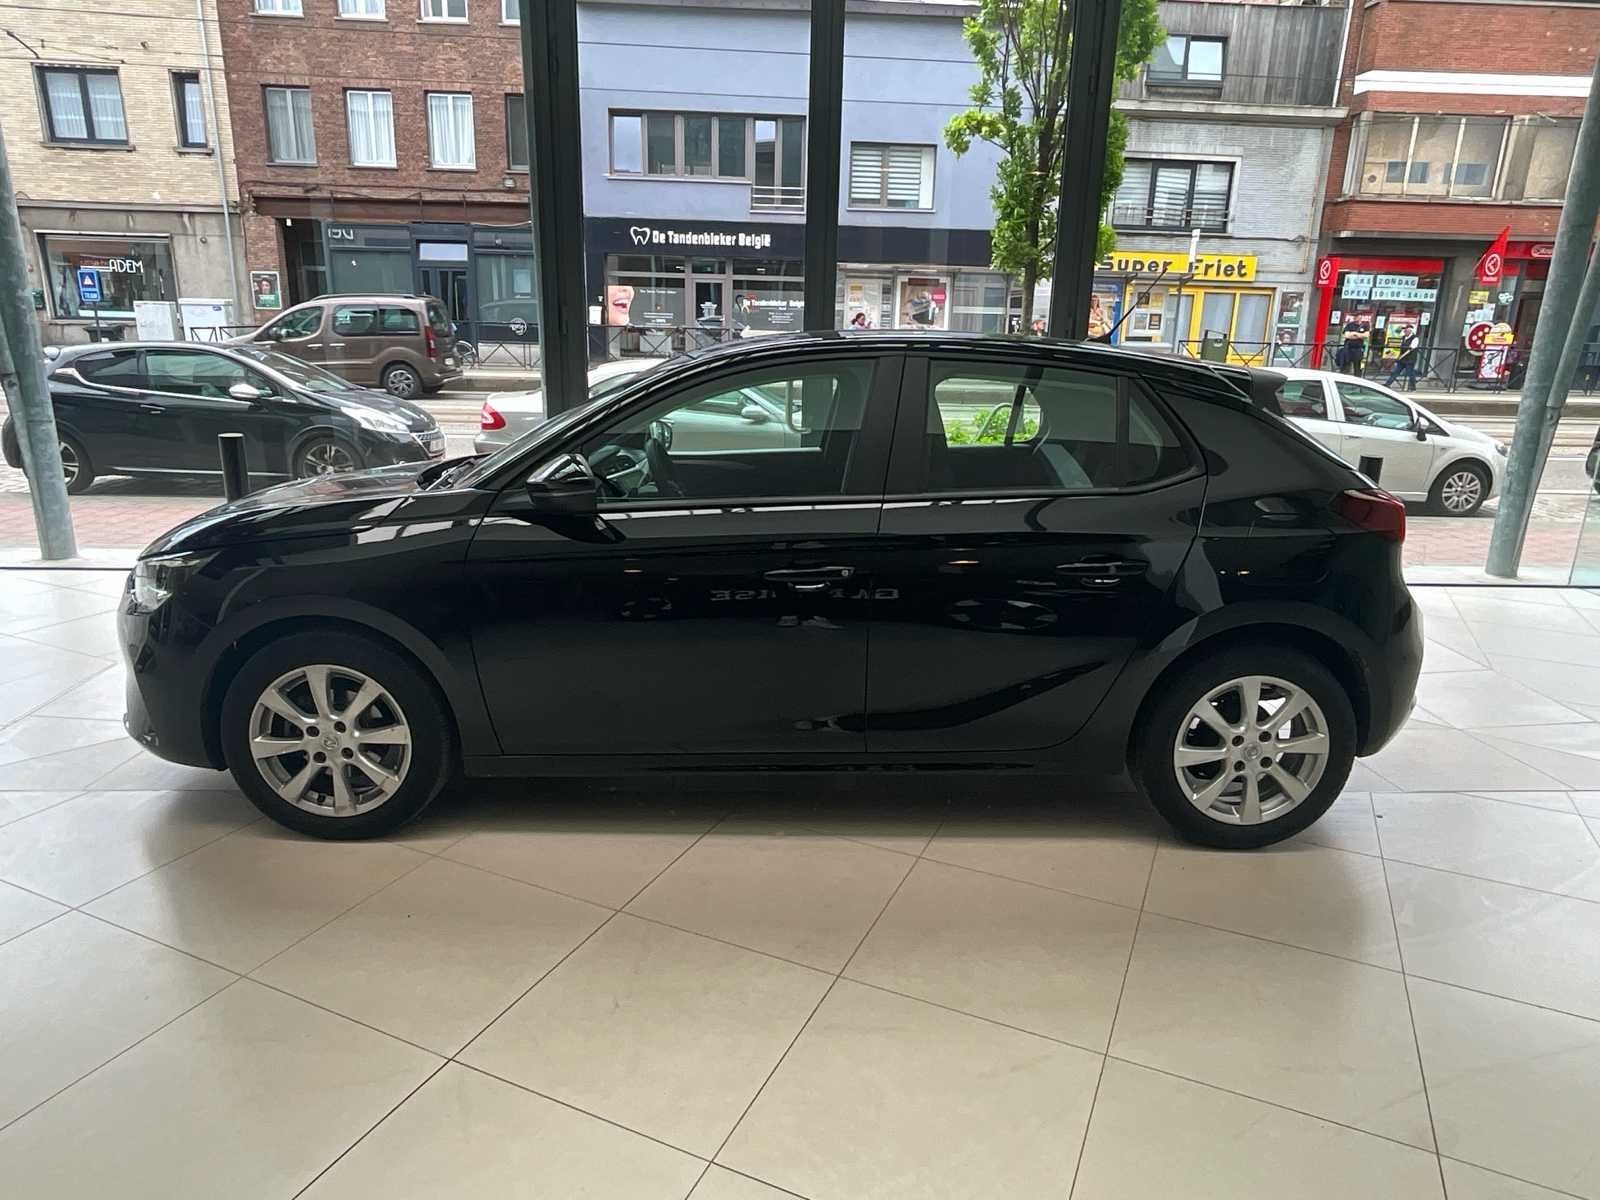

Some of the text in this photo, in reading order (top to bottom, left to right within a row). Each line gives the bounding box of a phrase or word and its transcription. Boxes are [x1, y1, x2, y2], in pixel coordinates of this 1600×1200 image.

[652, 230, 666, 243] De
[109, 259, 144, 273] ADEM
[1098, 255, 1247, 278] Super Friet
[1377, 278, 1416, 287] ZONDAG
[1344, 288, 1368, 297] OPEN
